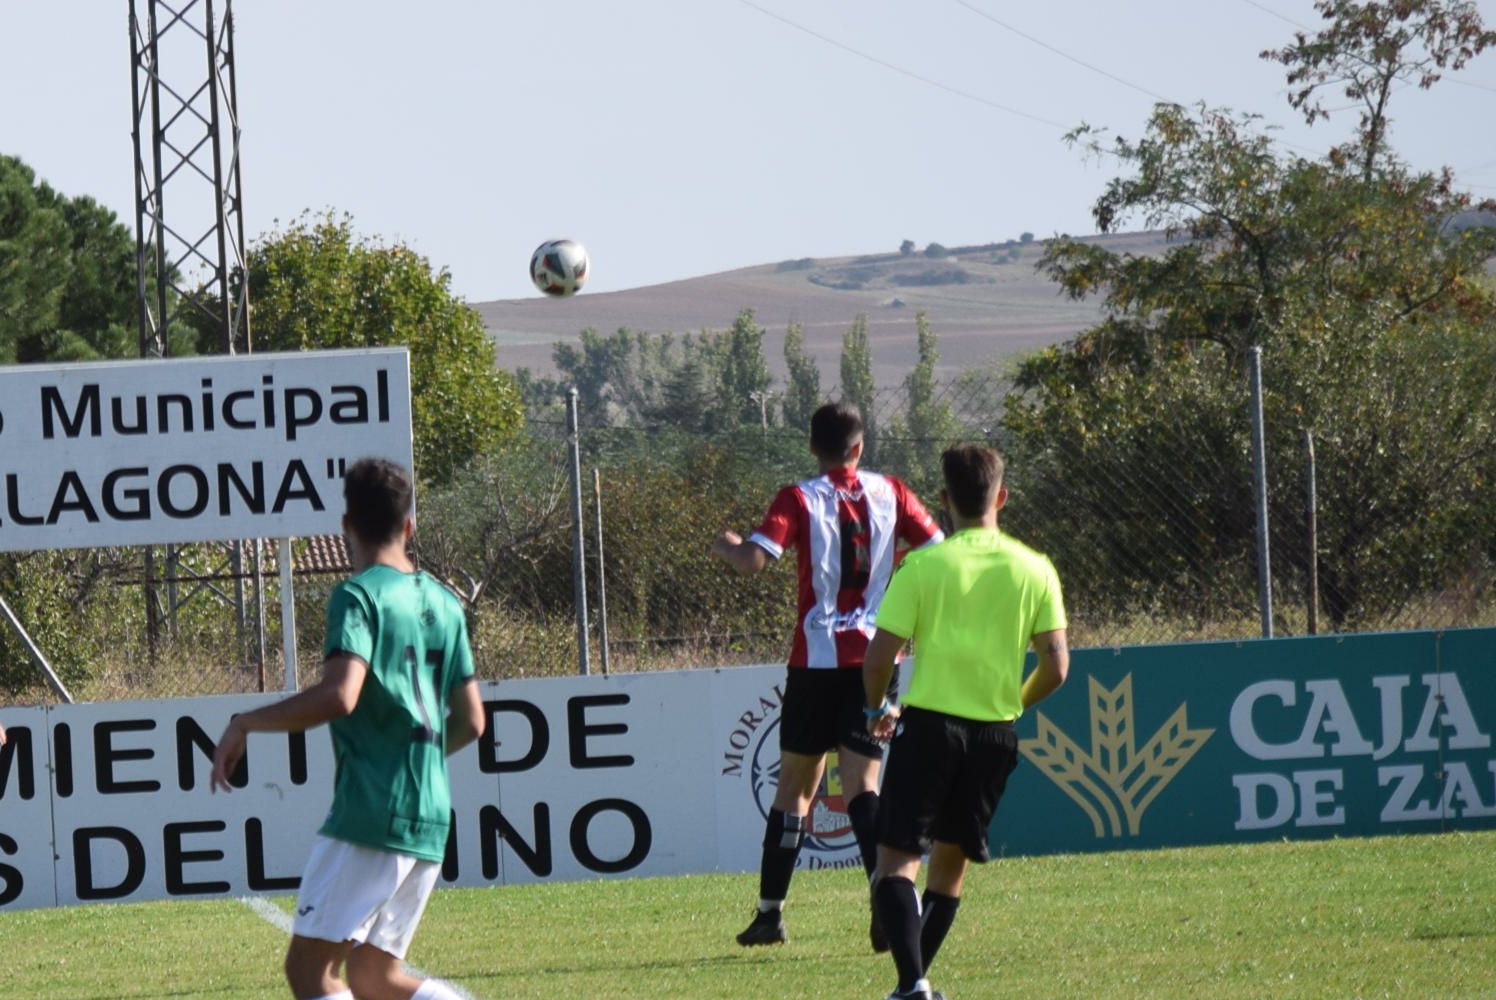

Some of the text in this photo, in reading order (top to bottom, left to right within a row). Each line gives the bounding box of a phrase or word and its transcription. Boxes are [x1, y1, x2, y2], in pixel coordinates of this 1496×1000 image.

[41, 369, 390, 442] Municipal
[478, 693, 635, 774] DE
[1229, 672, 1491, 761] CAJA
[1232, 760, 1496, 831] DE ZA
[72, 816, 303, 900] DEL
[442, 798, 653, 882] INO
